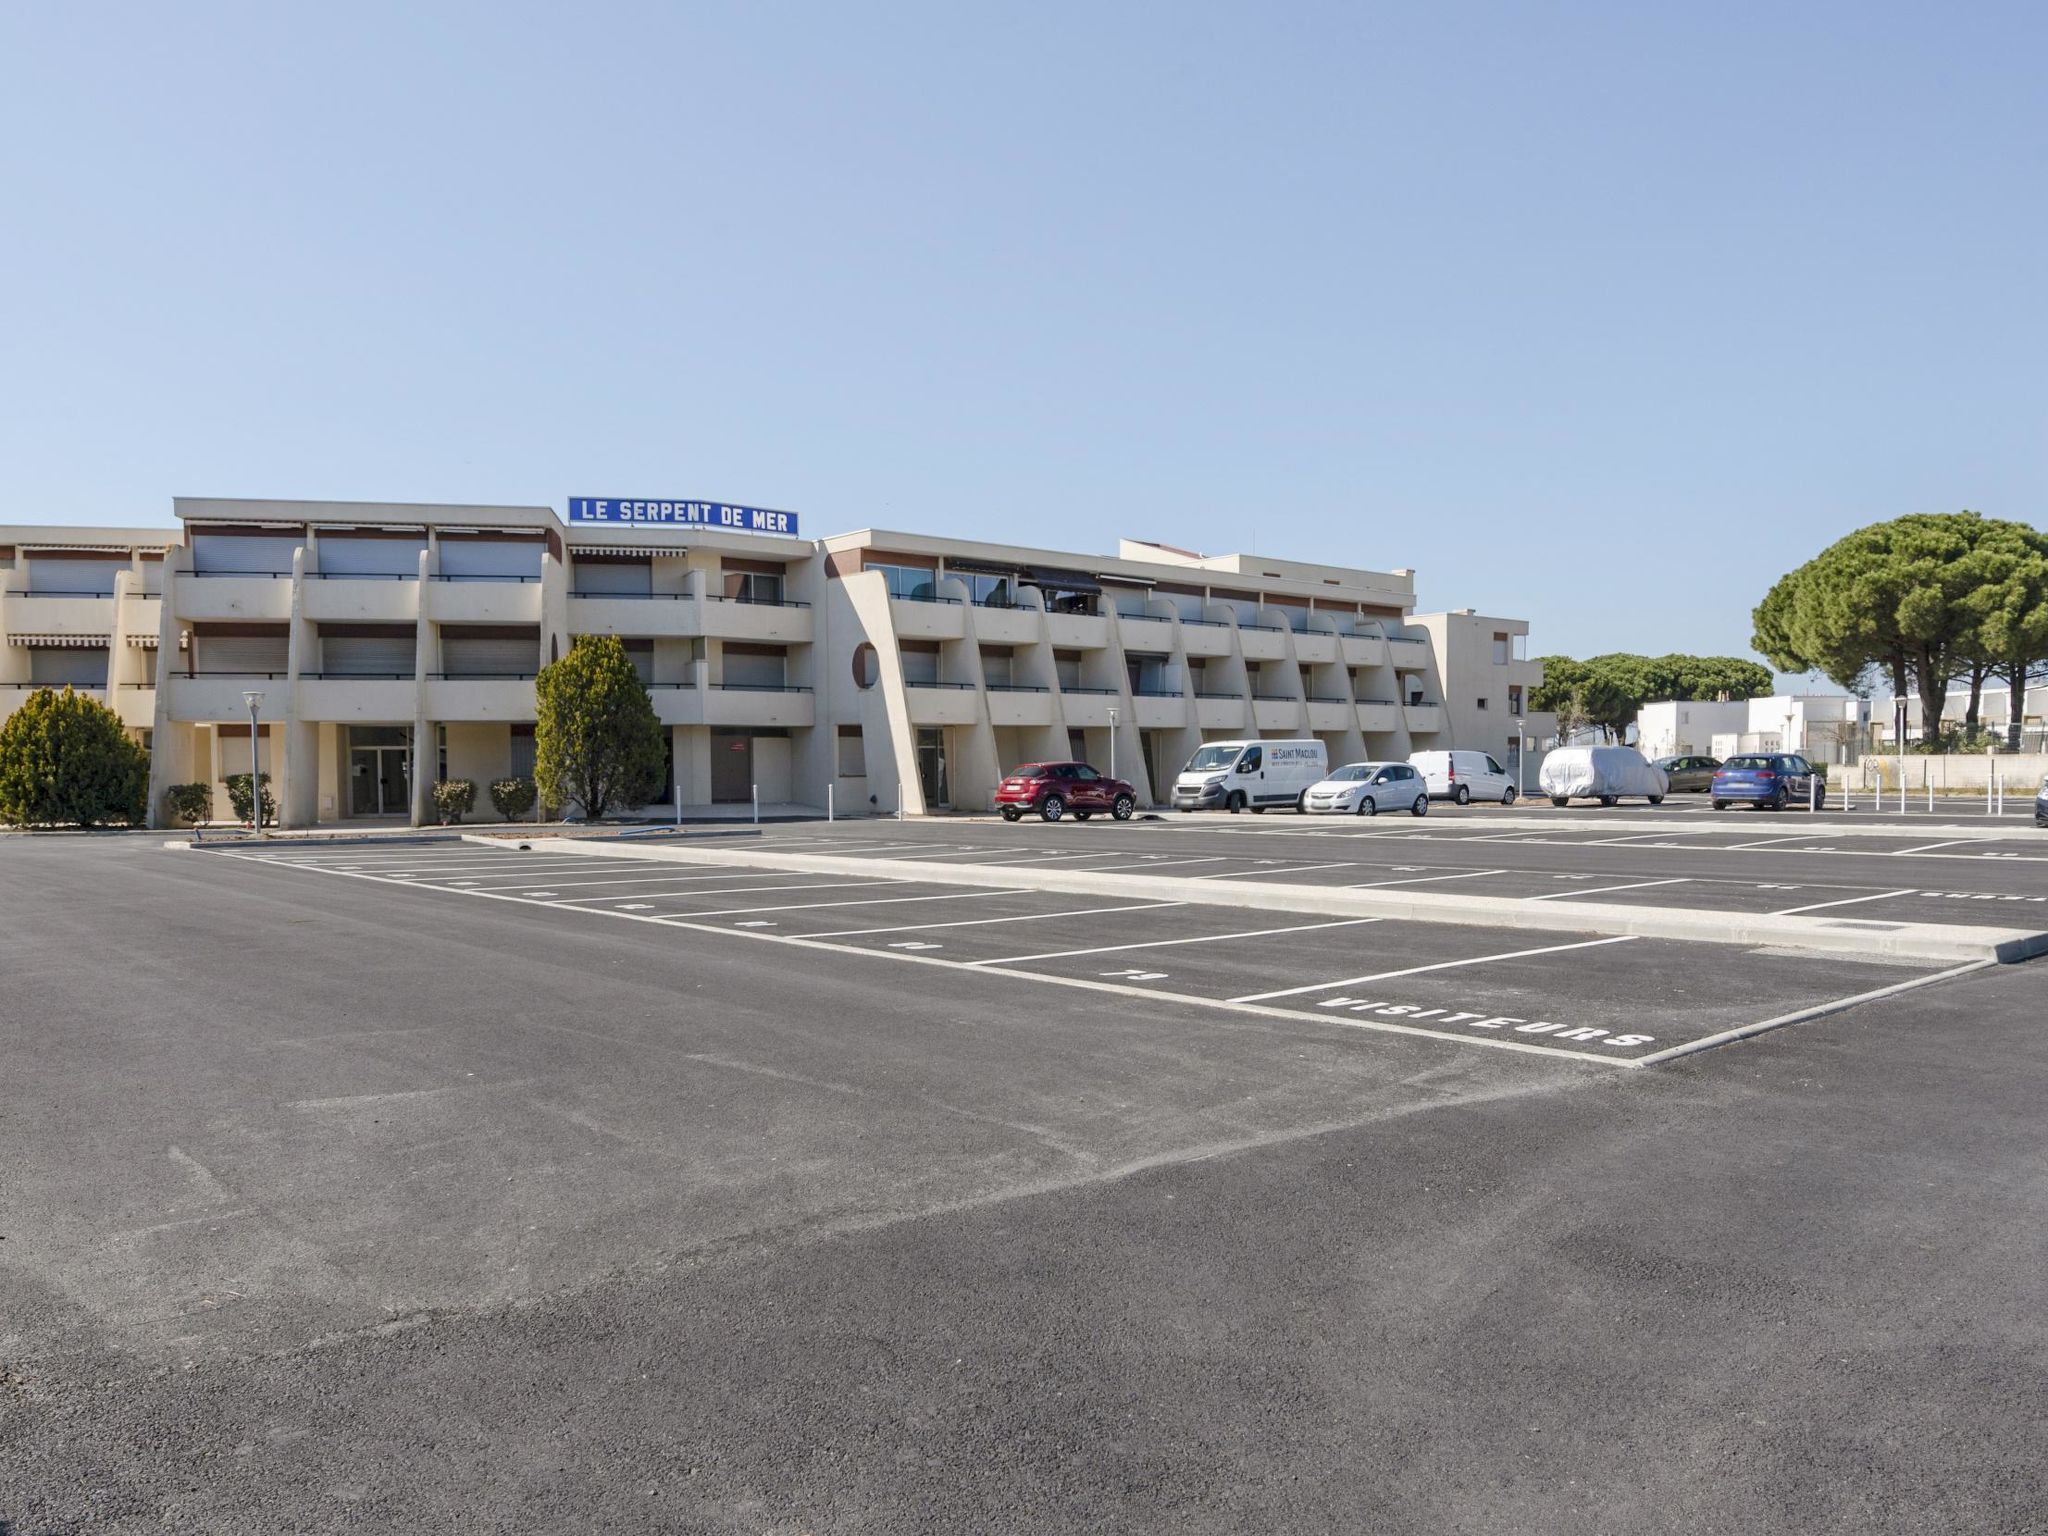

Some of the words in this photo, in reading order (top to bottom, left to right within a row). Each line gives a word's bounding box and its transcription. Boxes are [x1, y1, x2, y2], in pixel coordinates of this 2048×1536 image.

[581, 500, 608, 520] LE
[619, 501, 712, 523] SERPENT
[720, 507, 743, 527] DE
[752, 510, 788, 532] MER
[1316, 997, 1656, 1047] VISITEURS
